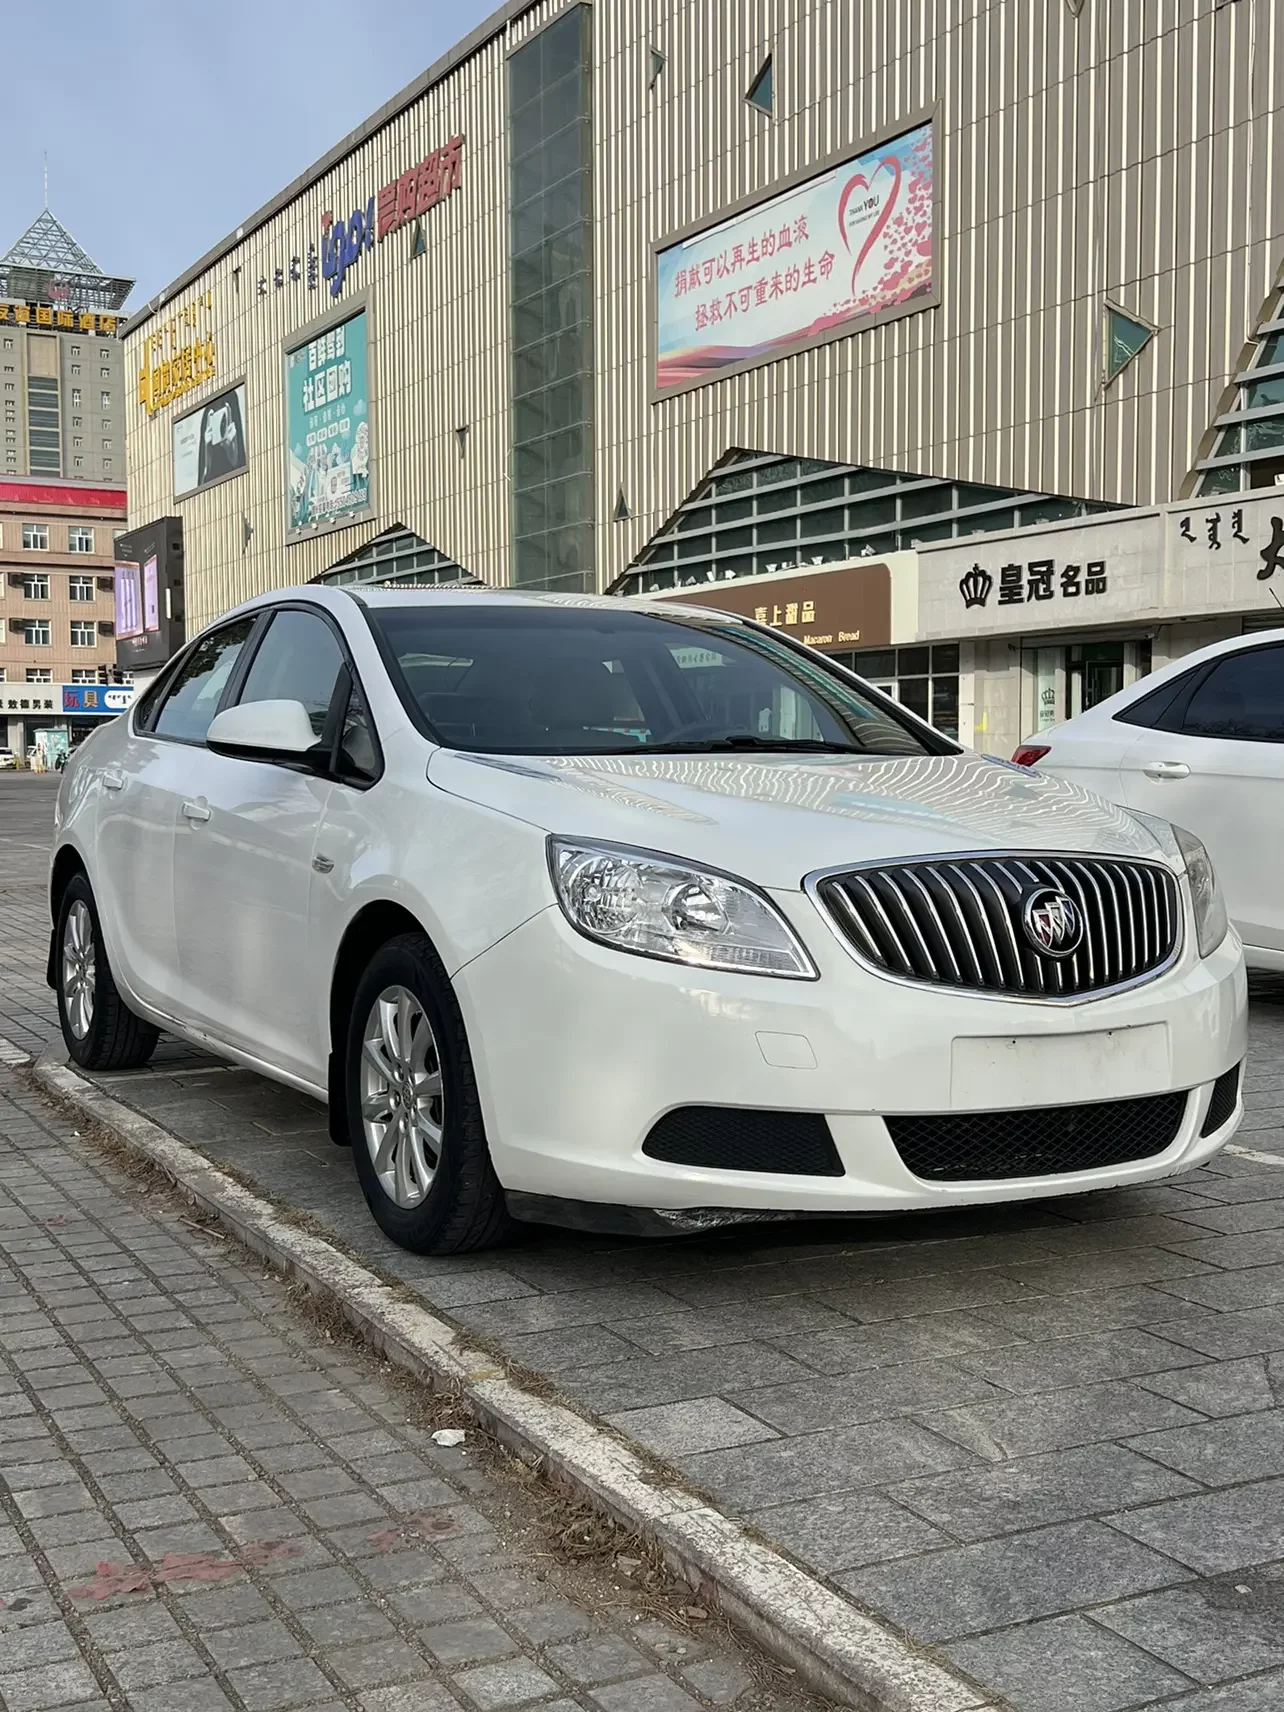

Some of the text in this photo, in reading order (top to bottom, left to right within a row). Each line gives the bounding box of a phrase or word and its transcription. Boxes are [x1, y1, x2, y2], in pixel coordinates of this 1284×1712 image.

[864, 194, 880, 211] YOU
[674, 214, 810, 299] 捐献可以再生的血液
[695, 249, 836, 332] 拯救不可重来的生命
[303, 360, 352, 413] 社区团购
[998, 559, 1108, 606] 皇冠名品
[803, 630, 860, 646] Macaron Bread
[64, 689, 98, 709] 玩具
